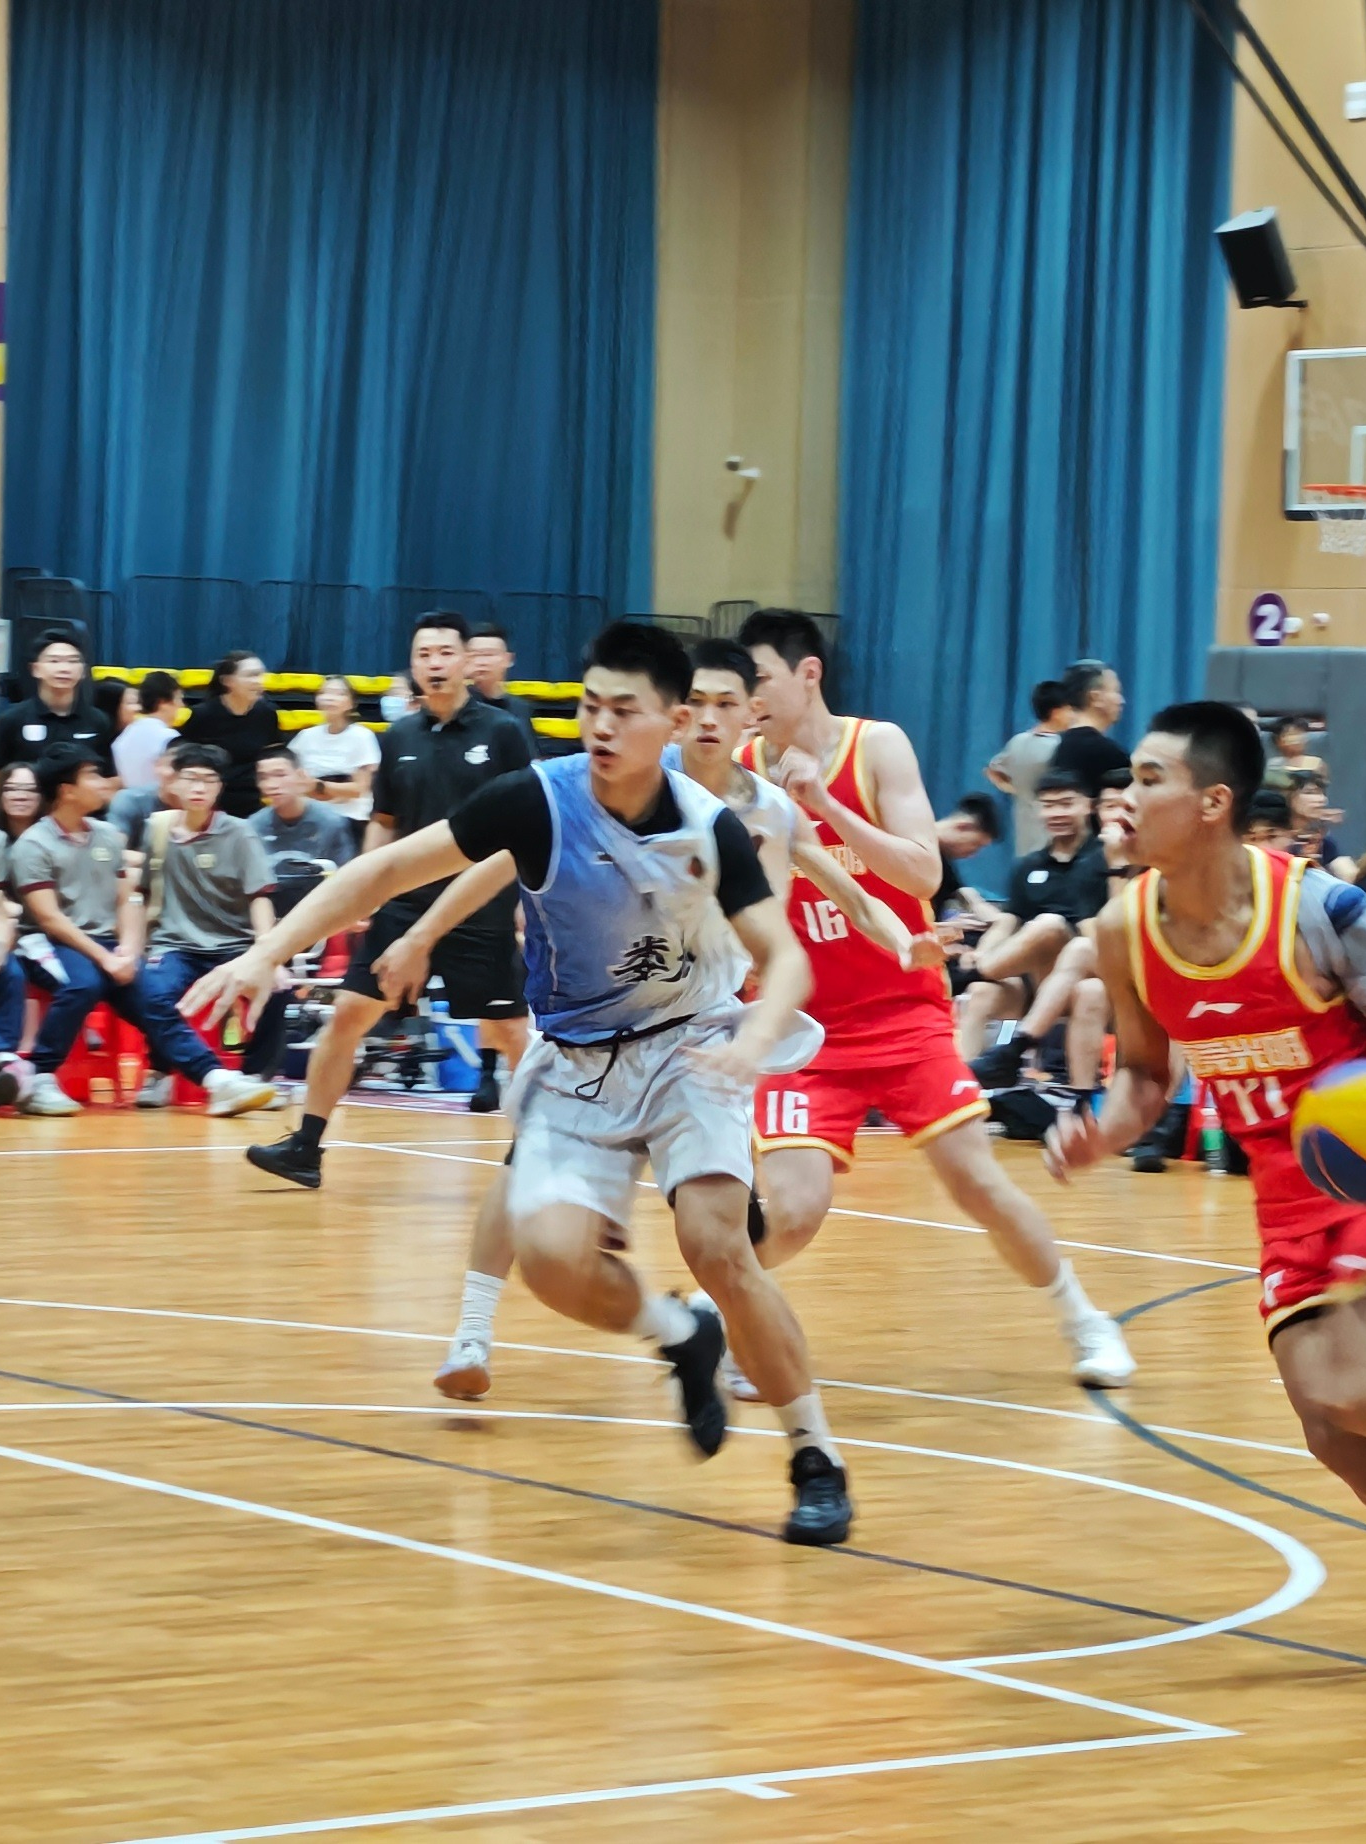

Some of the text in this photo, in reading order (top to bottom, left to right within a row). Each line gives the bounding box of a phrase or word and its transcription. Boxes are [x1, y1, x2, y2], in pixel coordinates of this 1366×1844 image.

[1254, 603, 1281, 640] 2
[802, 900, 849, 943] 16
[765, 1090, 810, 1136] 16
